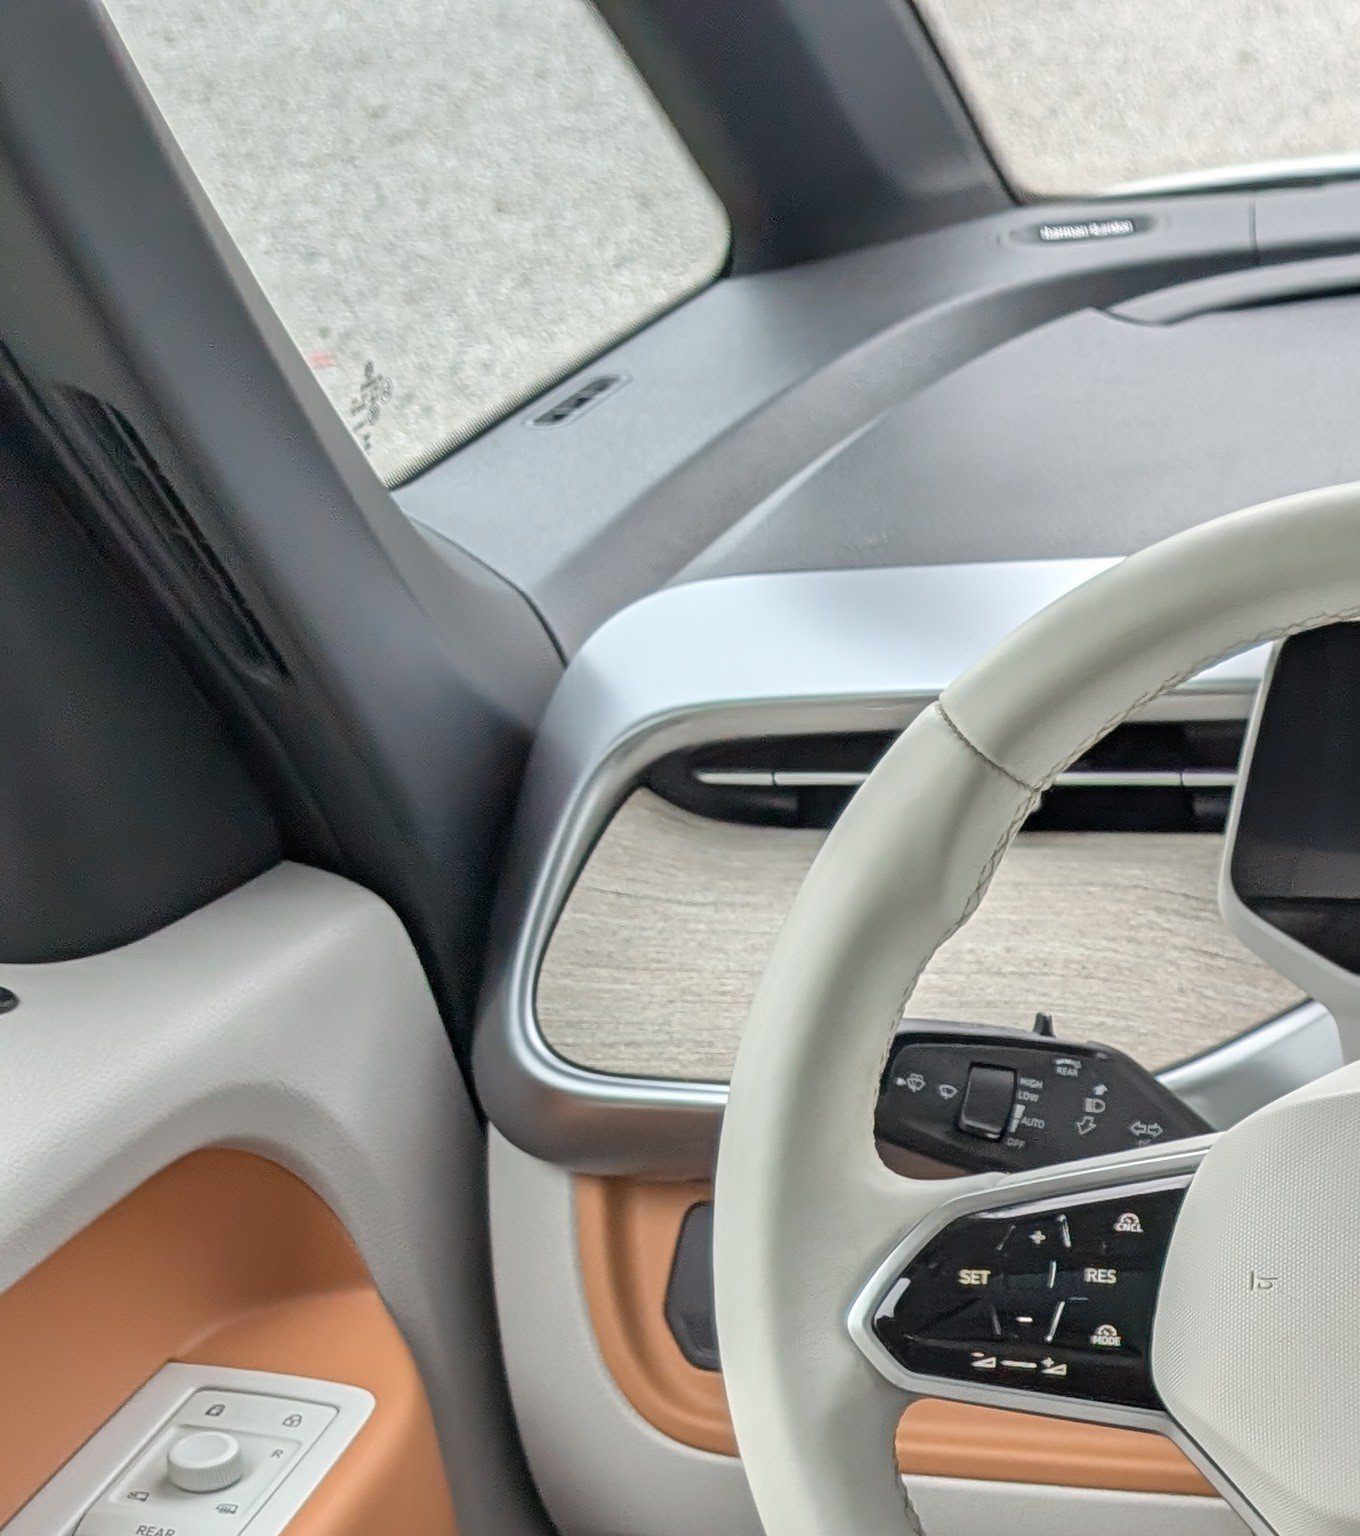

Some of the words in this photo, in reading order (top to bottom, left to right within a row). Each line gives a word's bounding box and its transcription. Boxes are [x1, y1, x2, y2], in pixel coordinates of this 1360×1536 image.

[1017, 1089, 1040, 1103] LOW
[1020, 1115, 1046, 1130] AUTO
[958, 1268, 991, 1285] SET
[1083, 1267, 1118, 1285] RES
[271, 1448, 283, 1459] R
